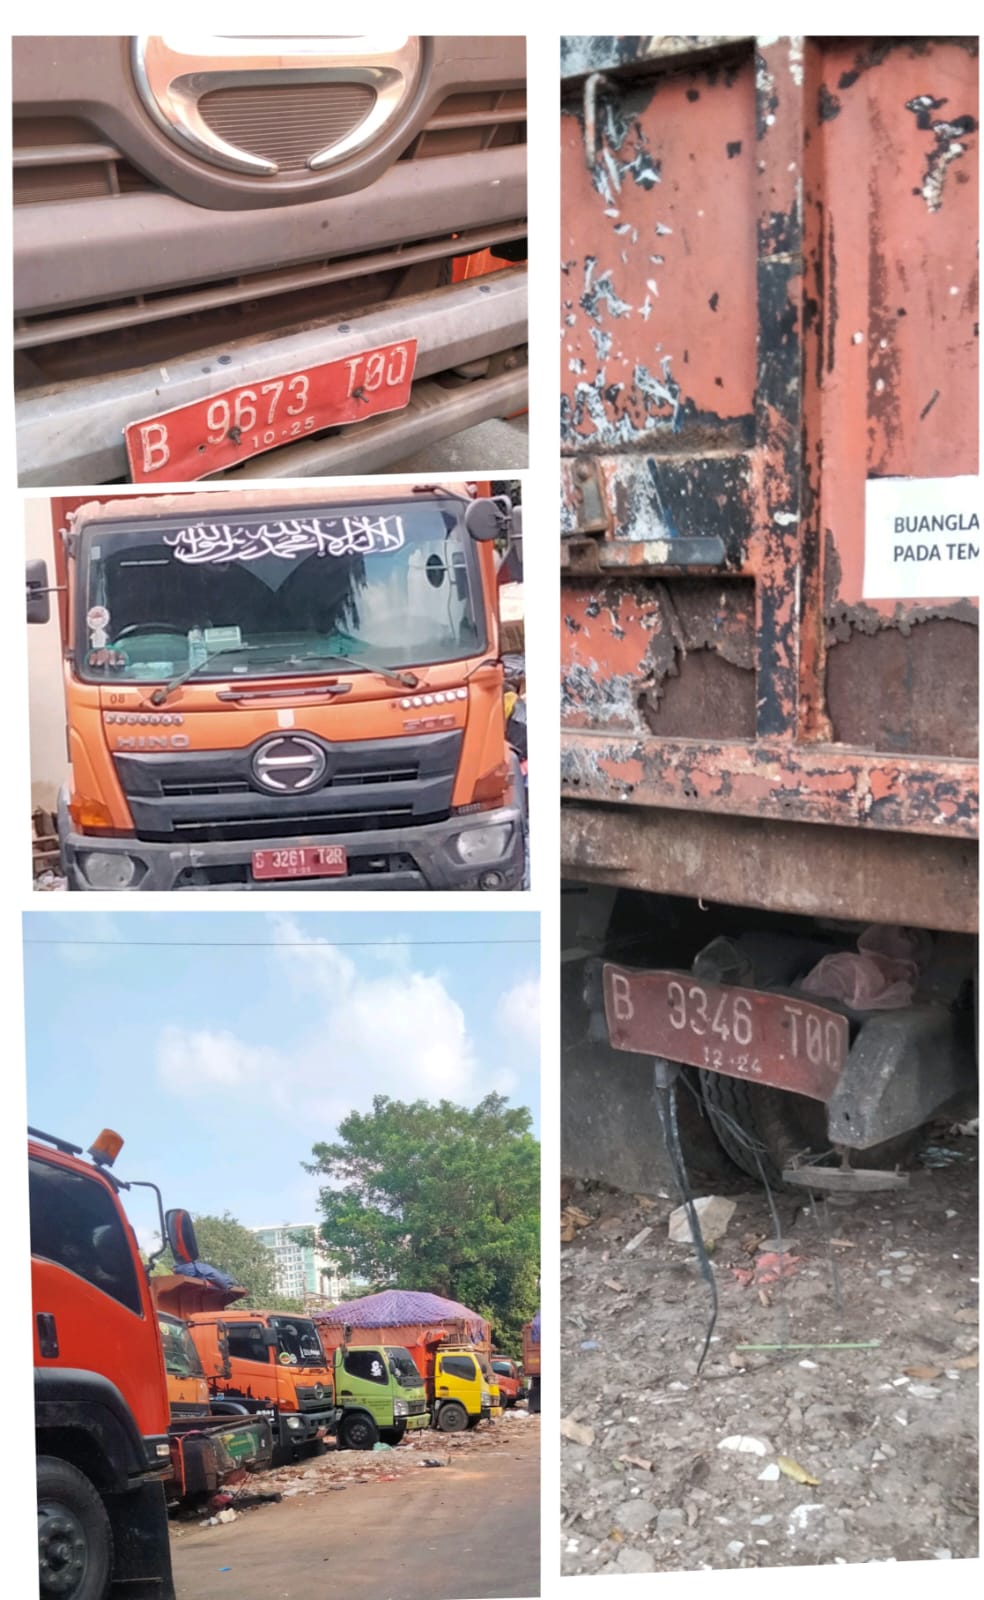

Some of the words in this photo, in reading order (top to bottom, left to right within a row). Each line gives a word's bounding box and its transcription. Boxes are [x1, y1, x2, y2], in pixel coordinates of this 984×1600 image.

[140, 423, 170, 473] B
[206, 375, 310, 444] 9673
[893, 543, 942, 562] PADA
[117, 734, 190, 748] HINO
[611, 972, 634, 1020] B
